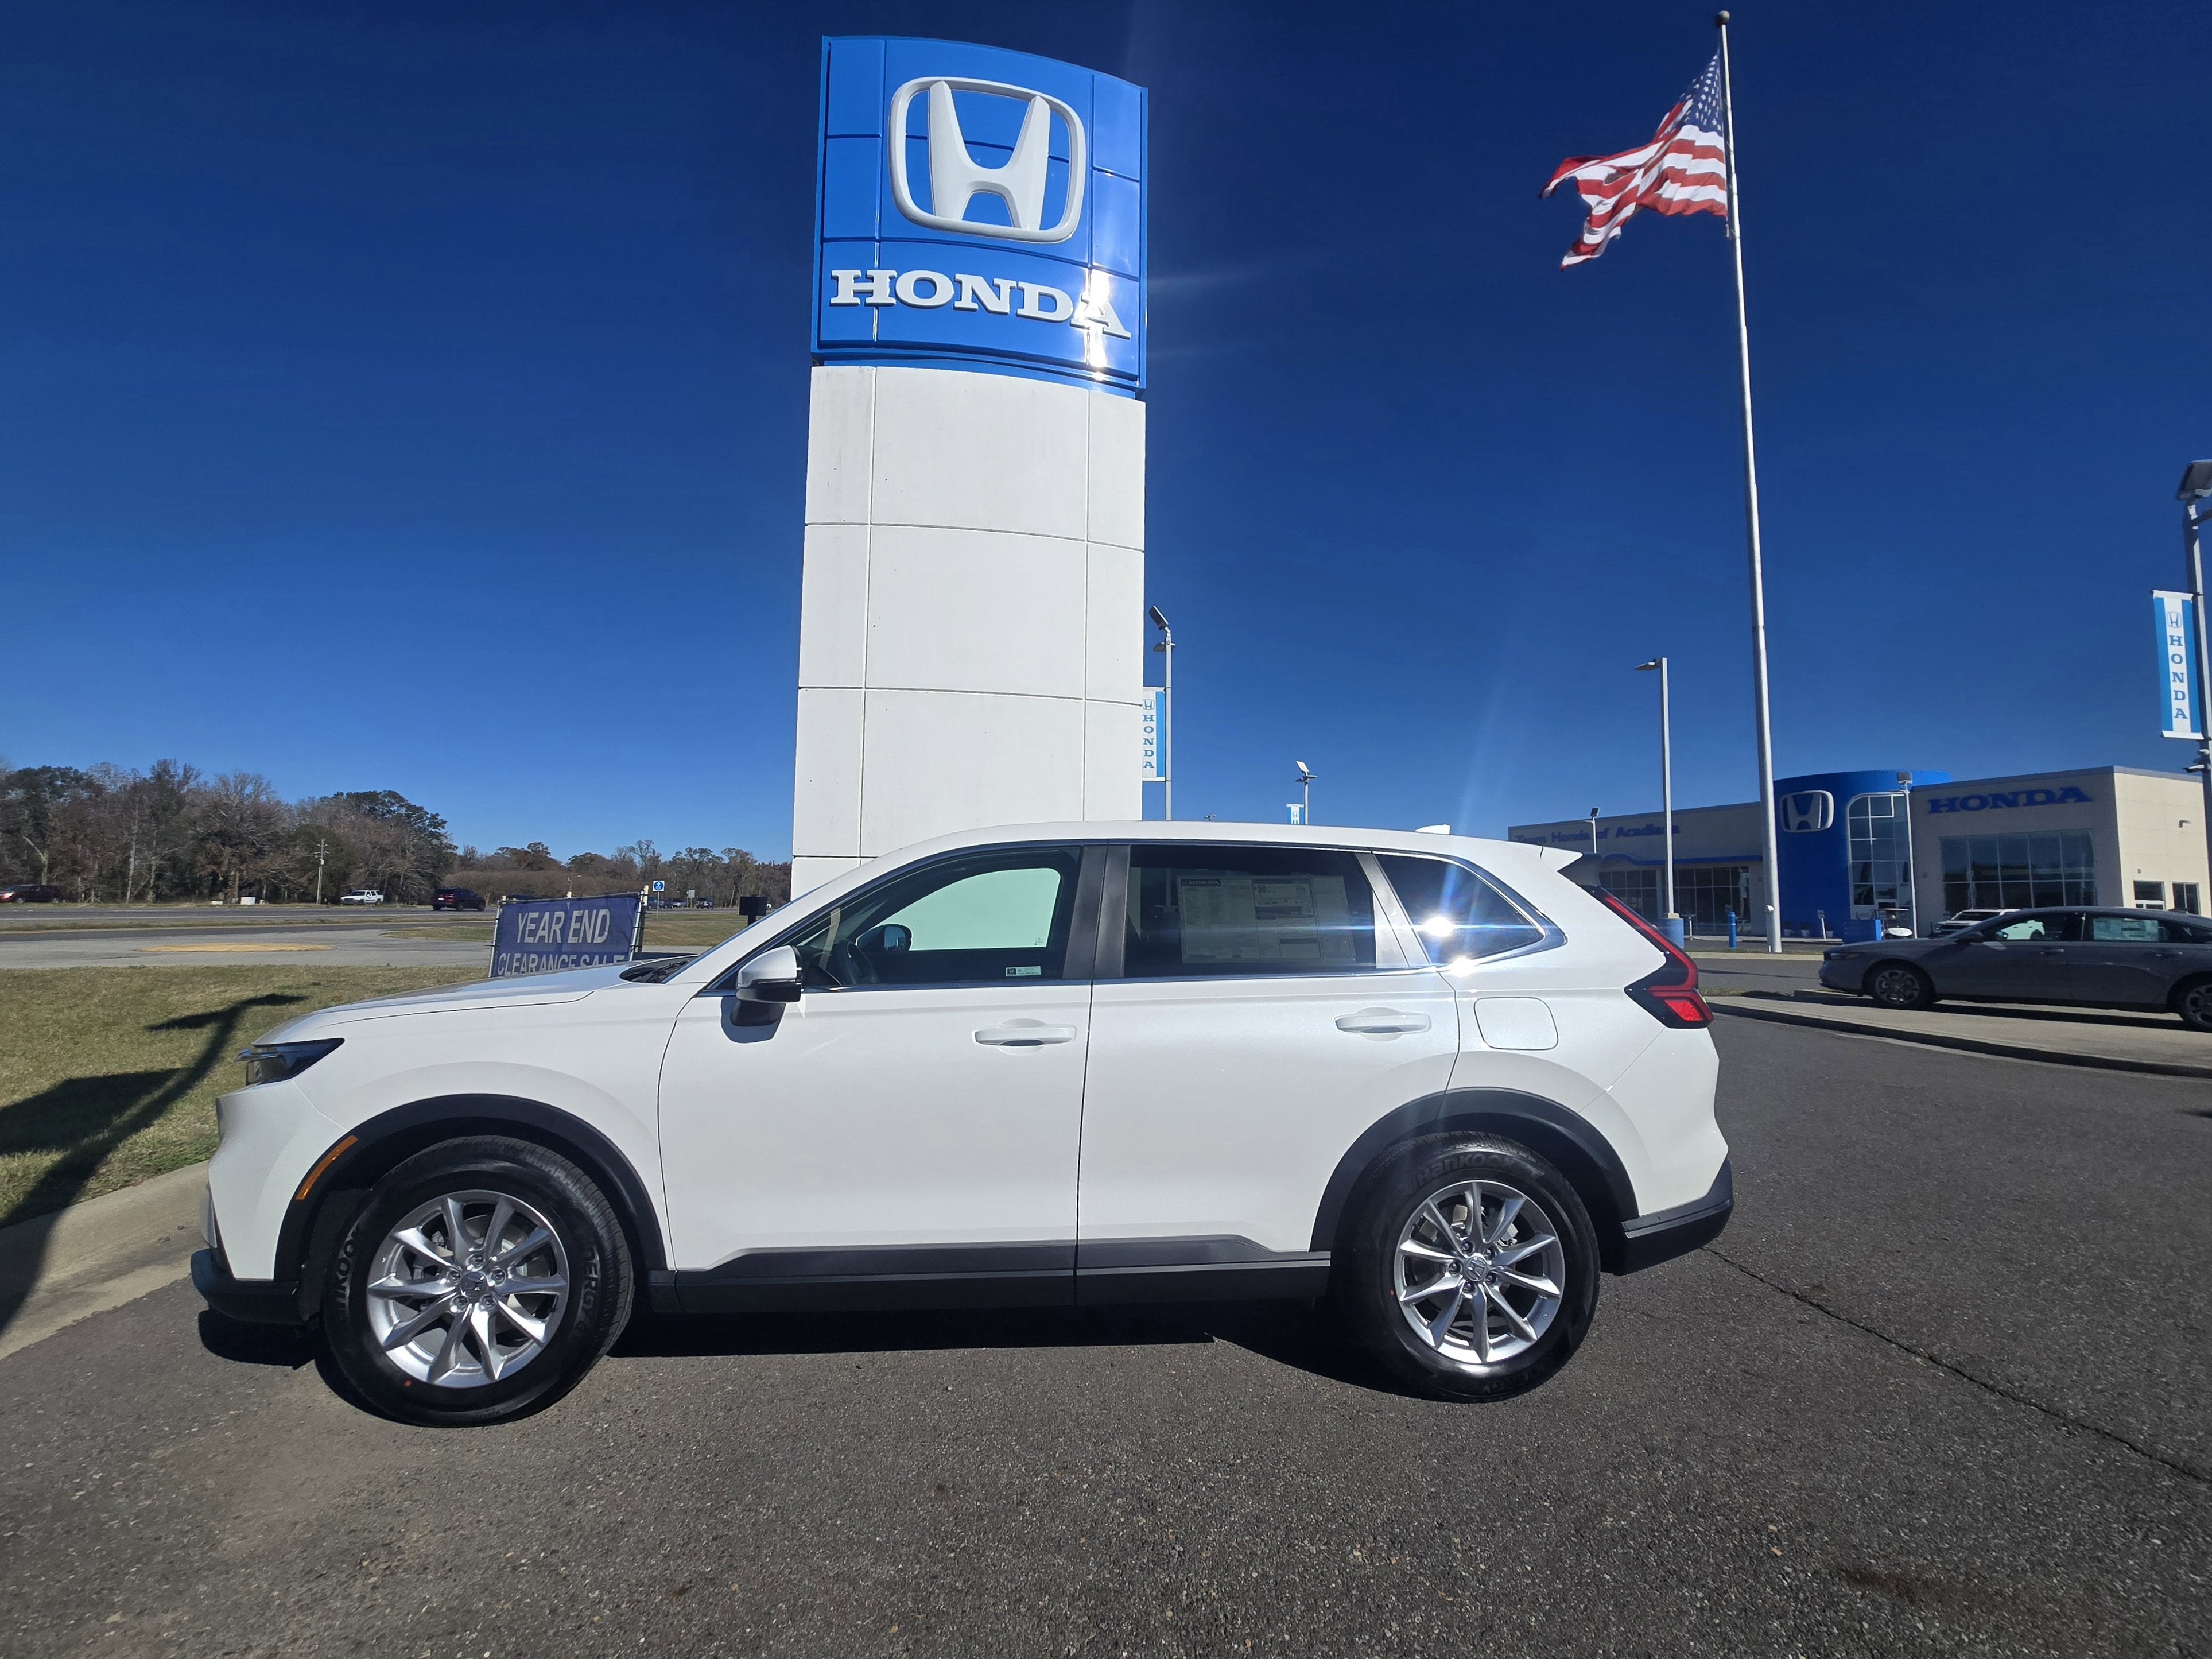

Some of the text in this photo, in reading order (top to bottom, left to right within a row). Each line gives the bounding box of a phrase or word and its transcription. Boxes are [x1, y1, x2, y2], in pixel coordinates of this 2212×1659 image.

[830, 269, 1131, 339] HONDA
[2169, 635, 2188, 719] HONDA
[1142, 714, 1155, 769] HONDA
[1928, 786, 2094, 815] HONDA
[1551, 831, 1590, 843] Honda
[1596, 827, 1610, 839] of
[1615, 824, 1681, 838] Acadiaa
[517, 909, 610, 944] YEAR END
[498, 952, 577, 976] CLEARANCE
